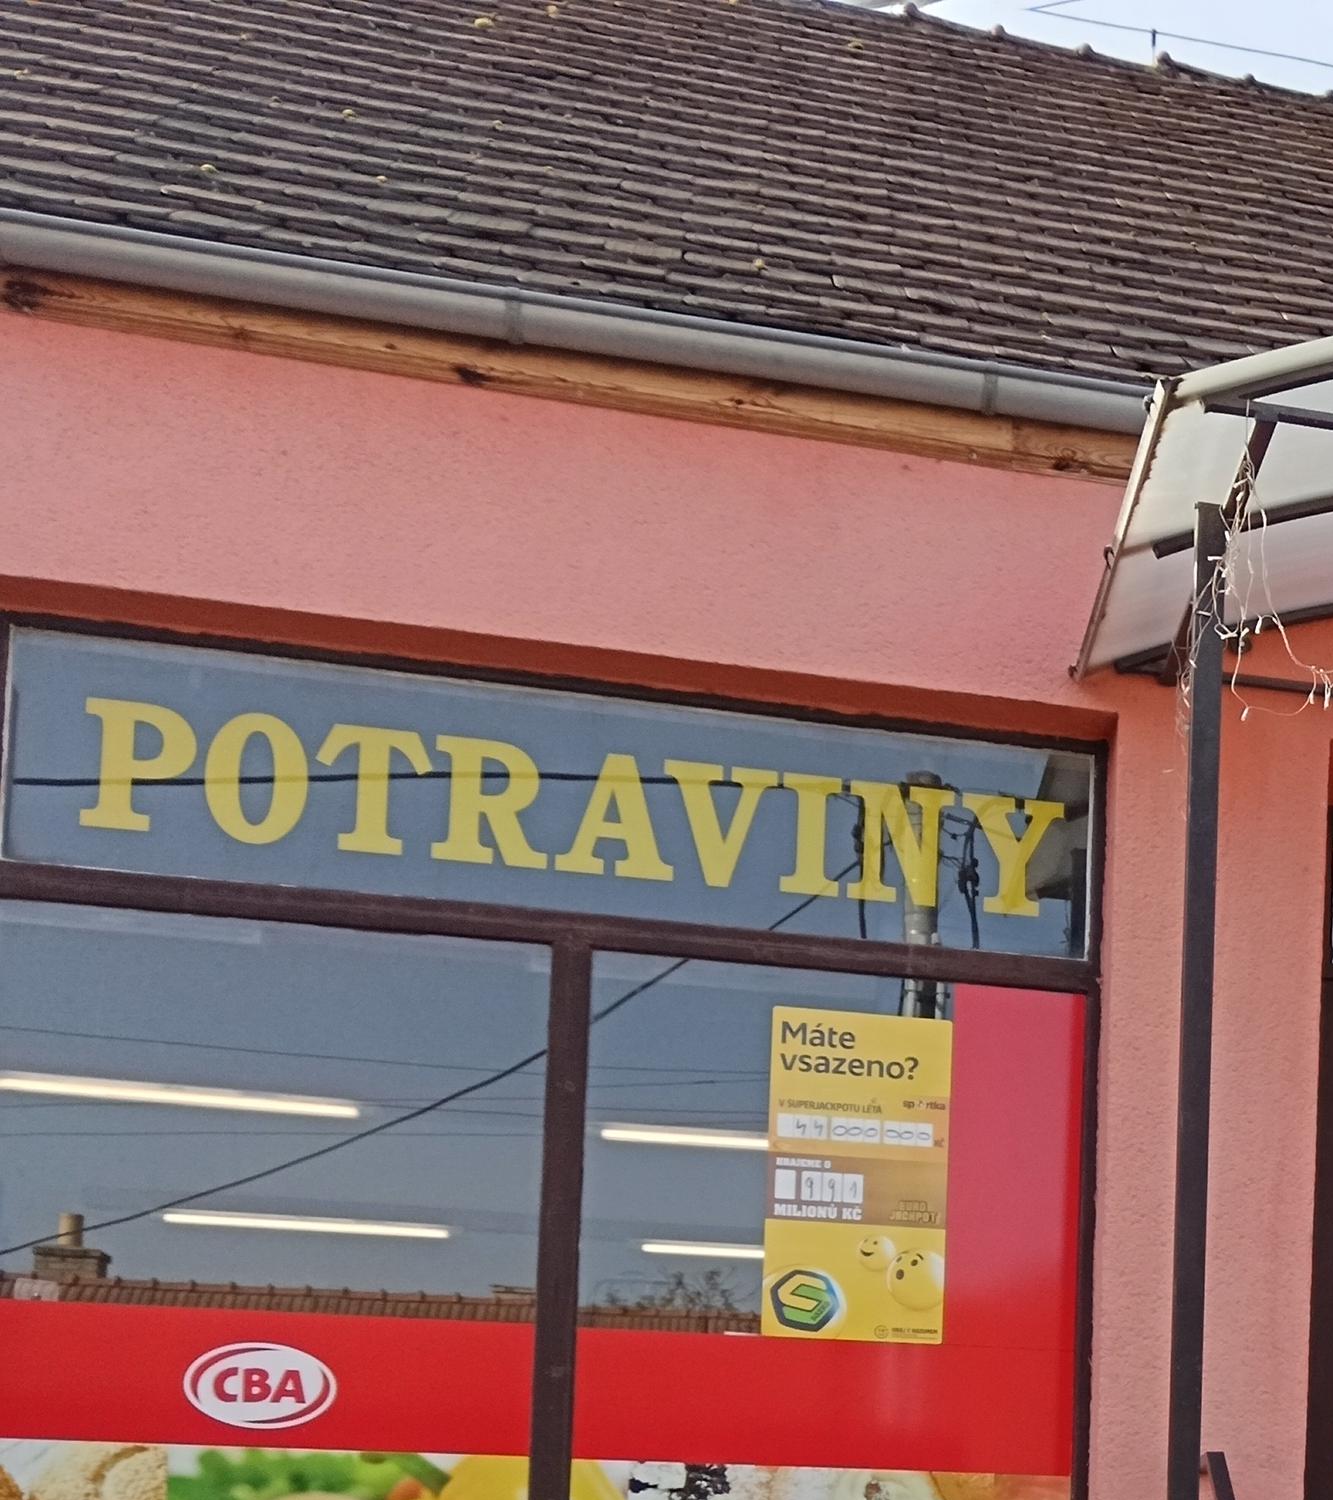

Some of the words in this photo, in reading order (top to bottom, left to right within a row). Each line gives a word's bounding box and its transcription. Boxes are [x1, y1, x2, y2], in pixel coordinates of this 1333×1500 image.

[79, 696, 1065, 918] POTRAVINY
[781, 1020, 856, 1050] Máte
[780, 1053, 919, 1081] vsazeno?
[211, 1368, 308, 1406] CBA
